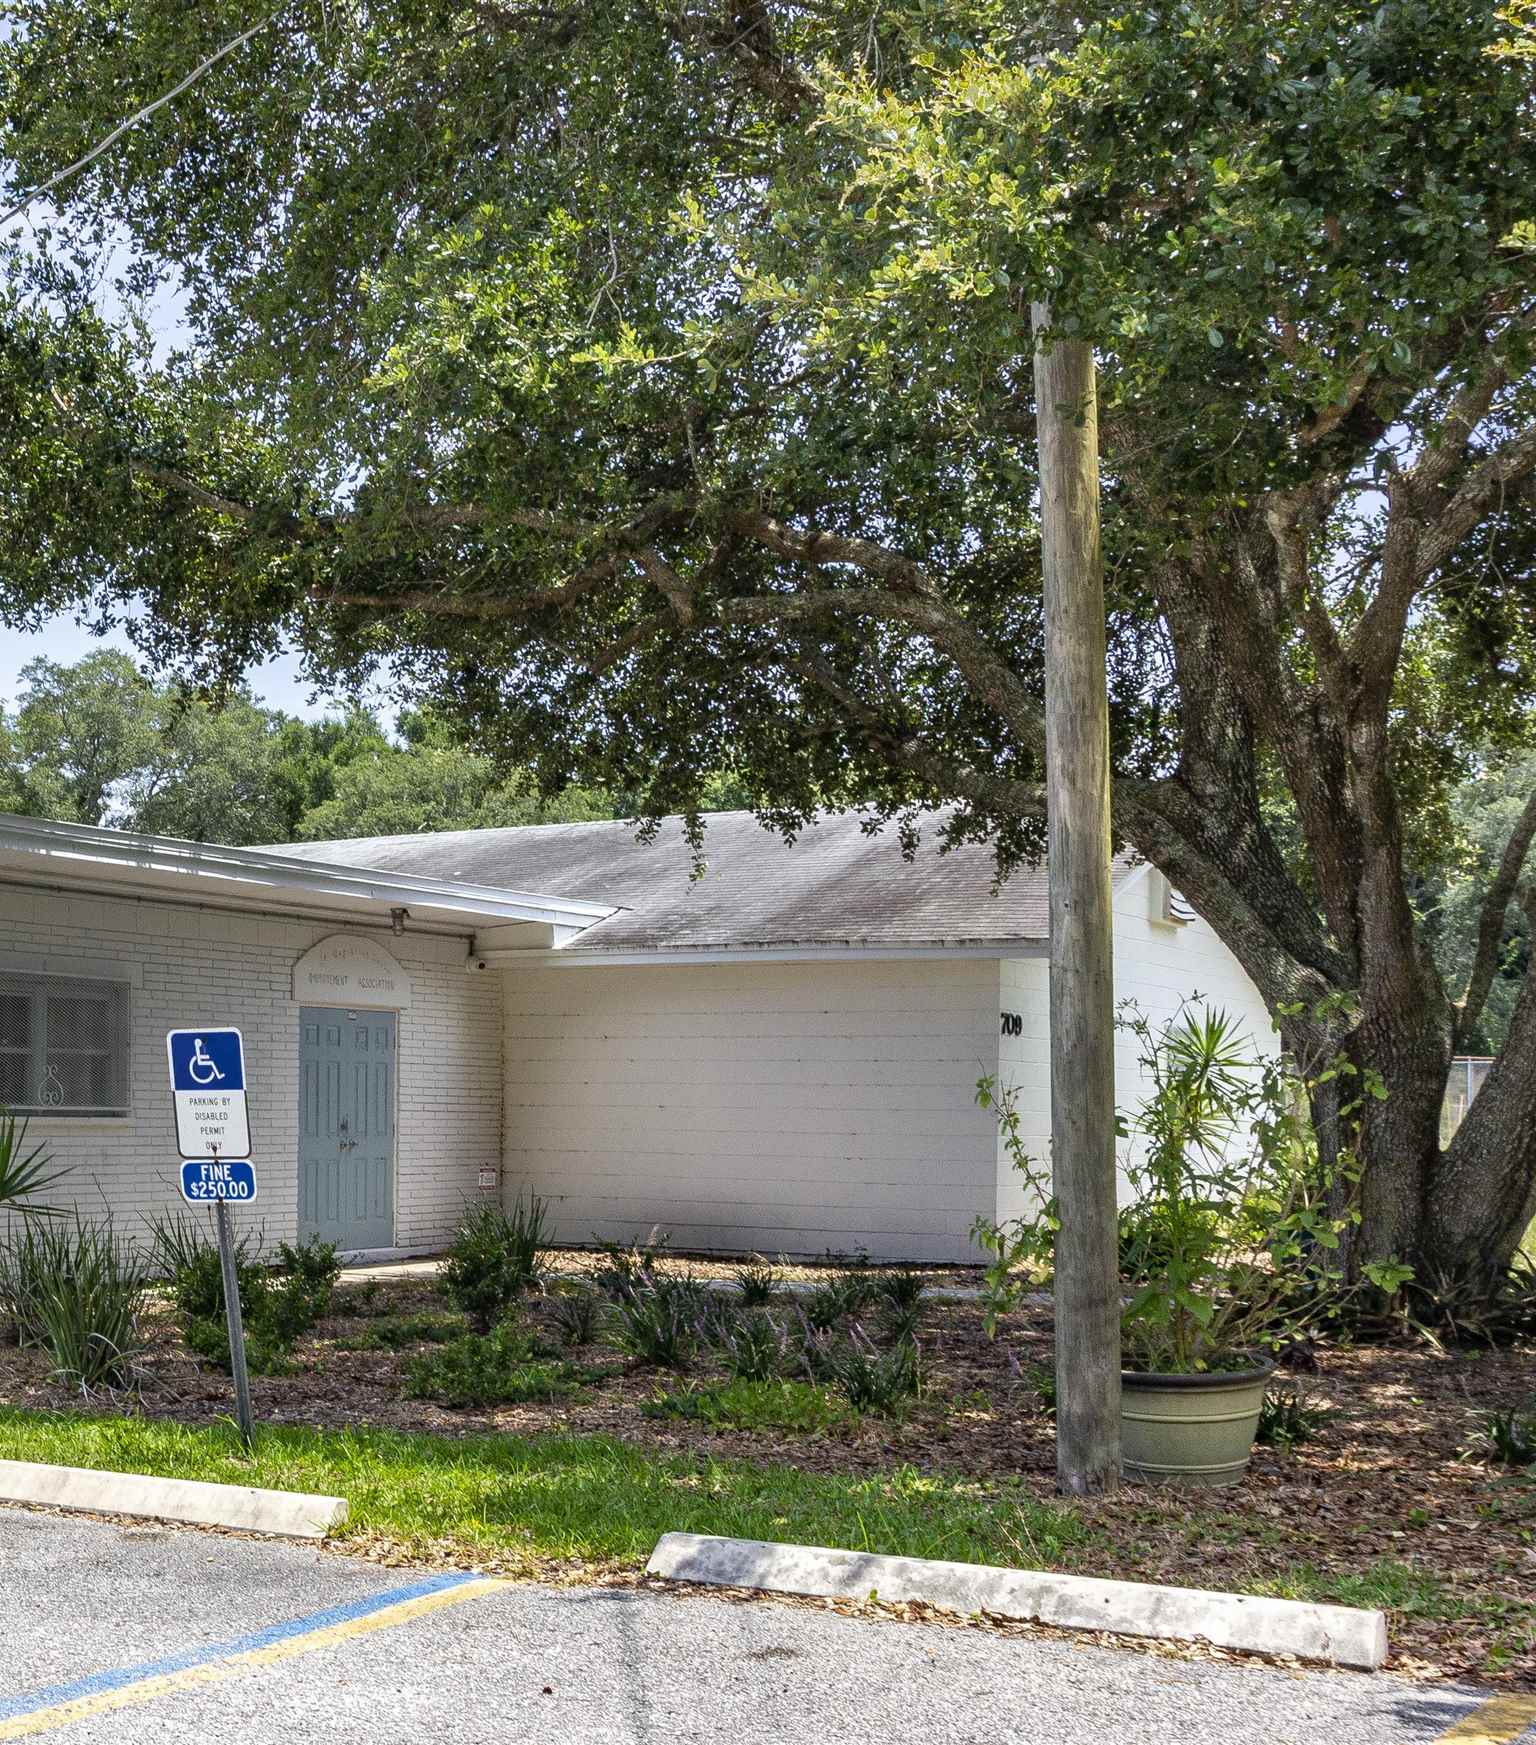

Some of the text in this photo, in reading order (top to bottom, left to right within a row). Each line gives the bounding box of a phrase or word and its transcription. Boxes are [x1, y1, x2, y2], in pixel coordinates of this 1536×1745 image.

[1000, 1012, 1023, 1036] 709
[189, 1097, 231, 1106] PARKING BY
[194, 1112, 229, 1121] DISABLED
[200, 1126, 225, 1136] PERMIT
[200, 1164, 233, 1181] FINE
[190, 1181, 249, 1198] $250.00
